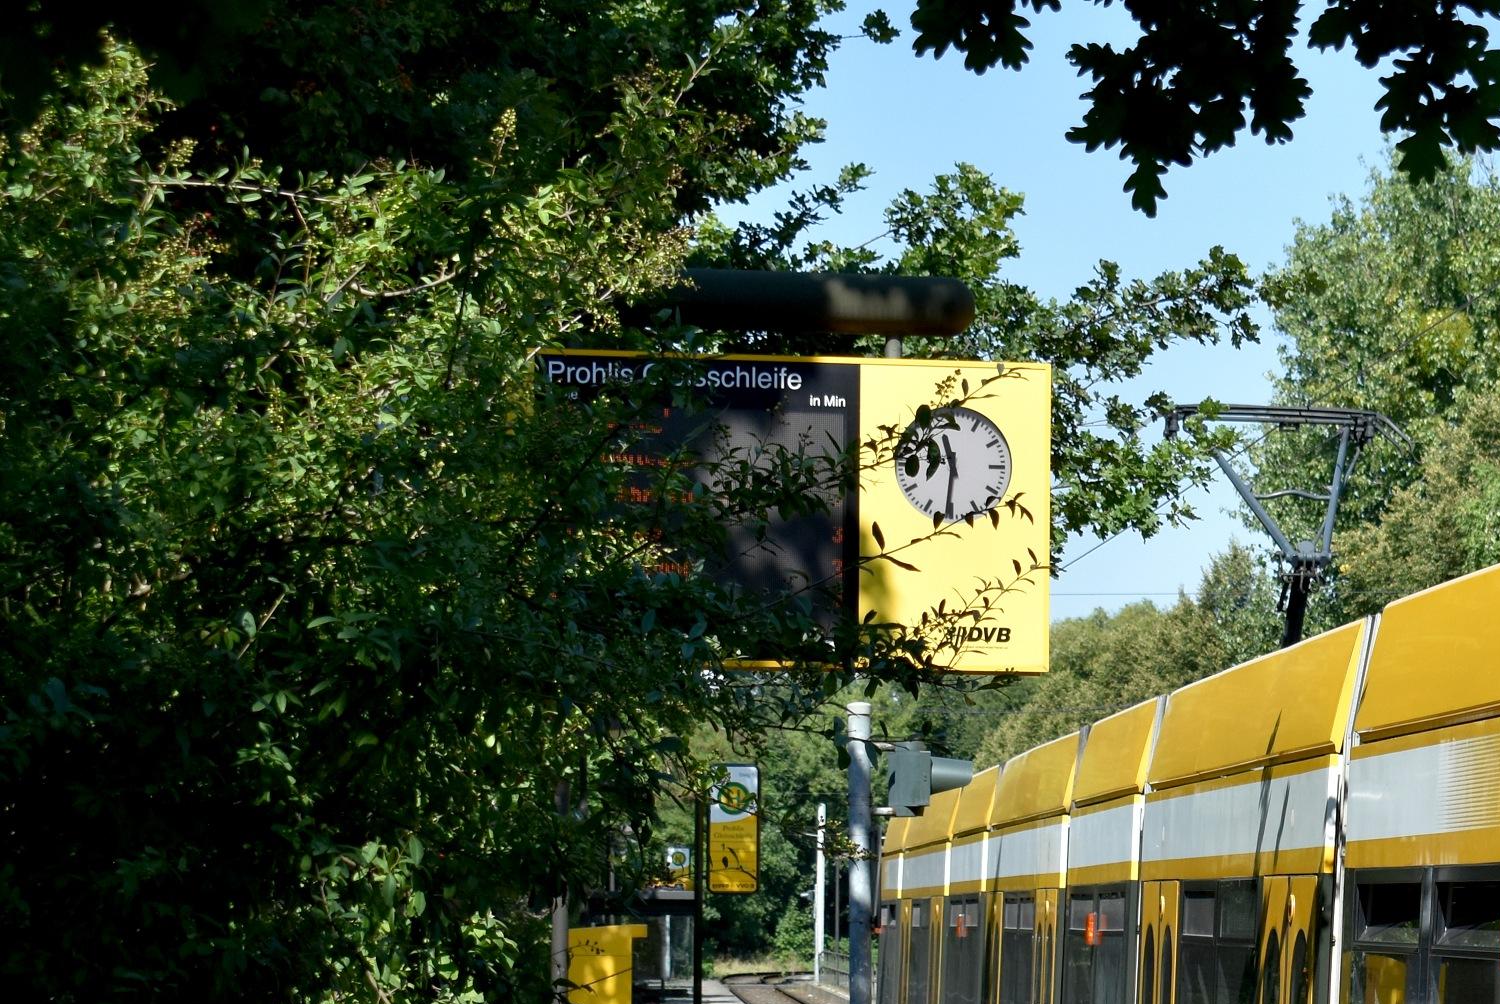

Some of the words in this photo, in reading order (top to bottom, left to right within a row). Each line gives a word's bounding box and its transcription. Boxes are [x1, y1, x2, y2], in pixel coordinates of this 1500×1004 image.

[810, 394, 821, 407] in
[824, 394, 846, 407] Min
[967, 626, 1011, 642] DVB
